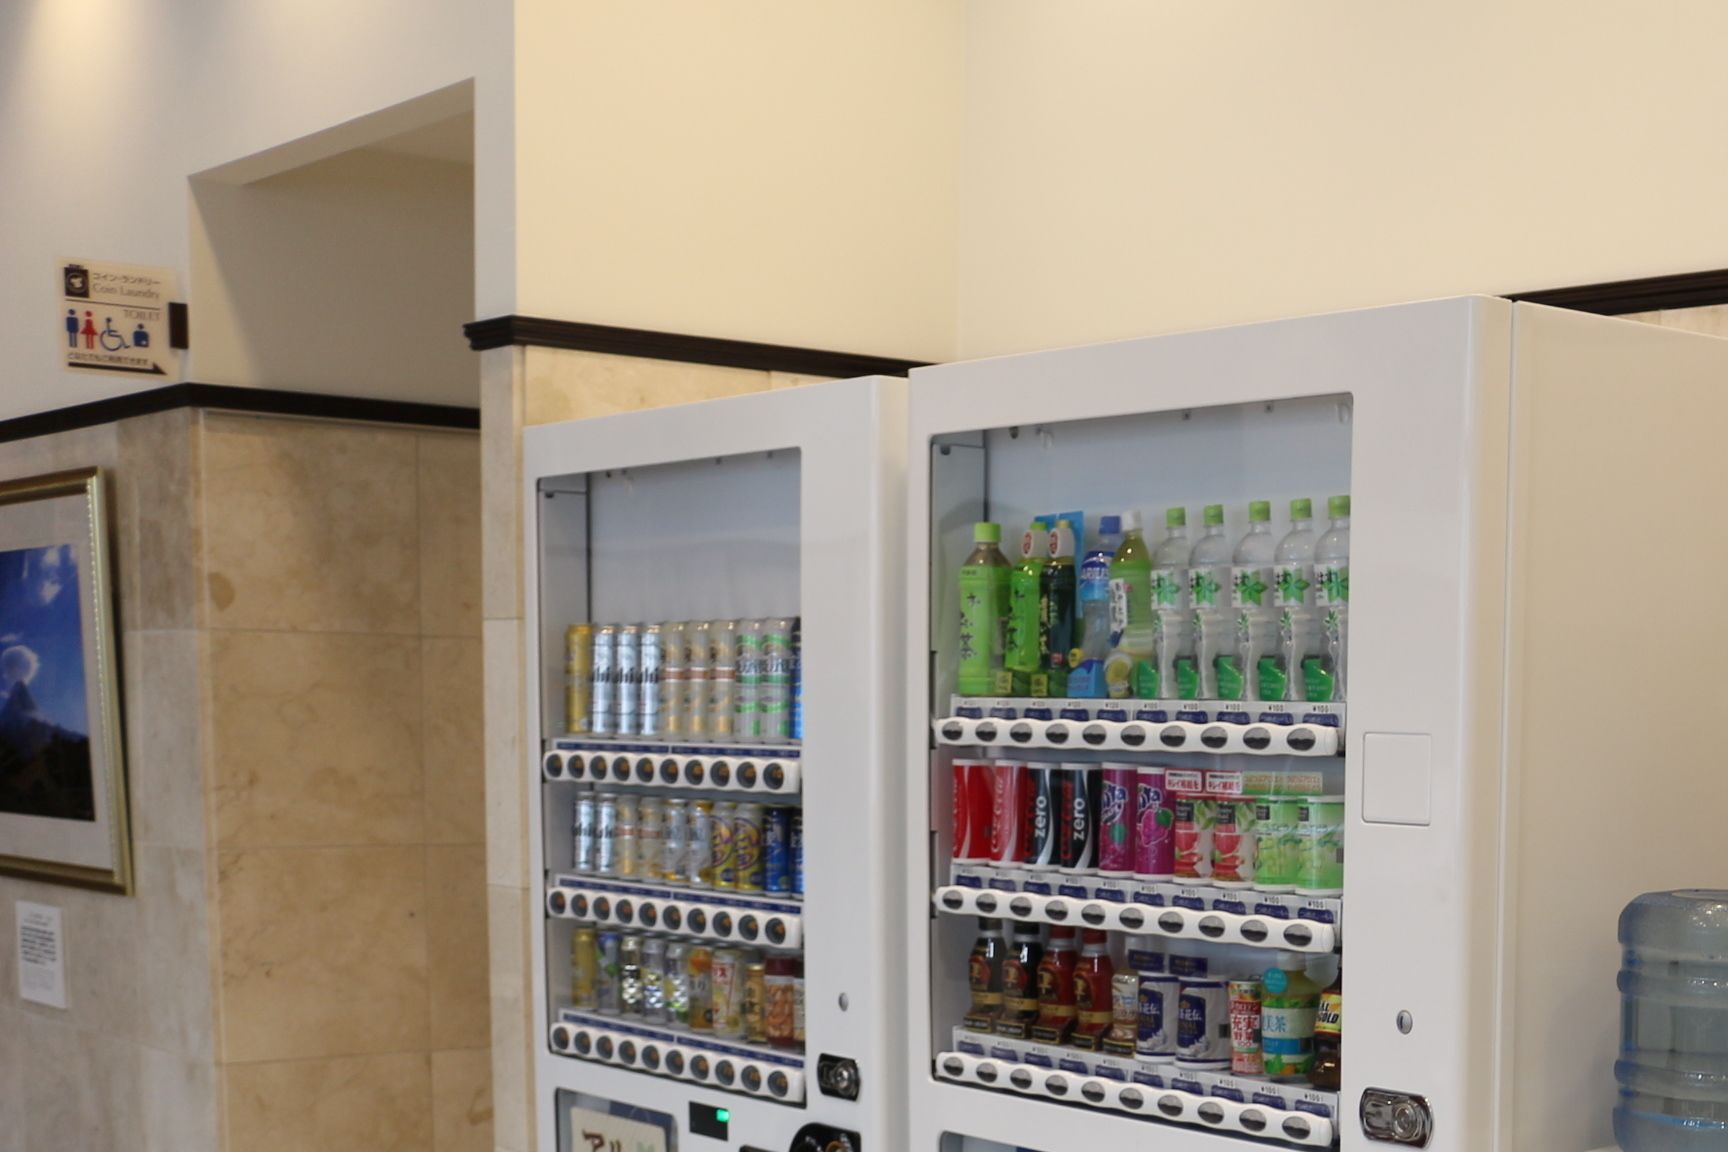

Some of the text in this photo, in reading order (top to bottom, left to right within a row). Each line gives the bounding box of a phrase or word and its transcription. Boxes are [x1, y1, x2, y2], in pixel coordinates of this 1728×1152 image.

[124, 309, 160, 321] TOILET
[1035, 796, 1047, 839] zero
[1073, 797, 1086, 841] zero
